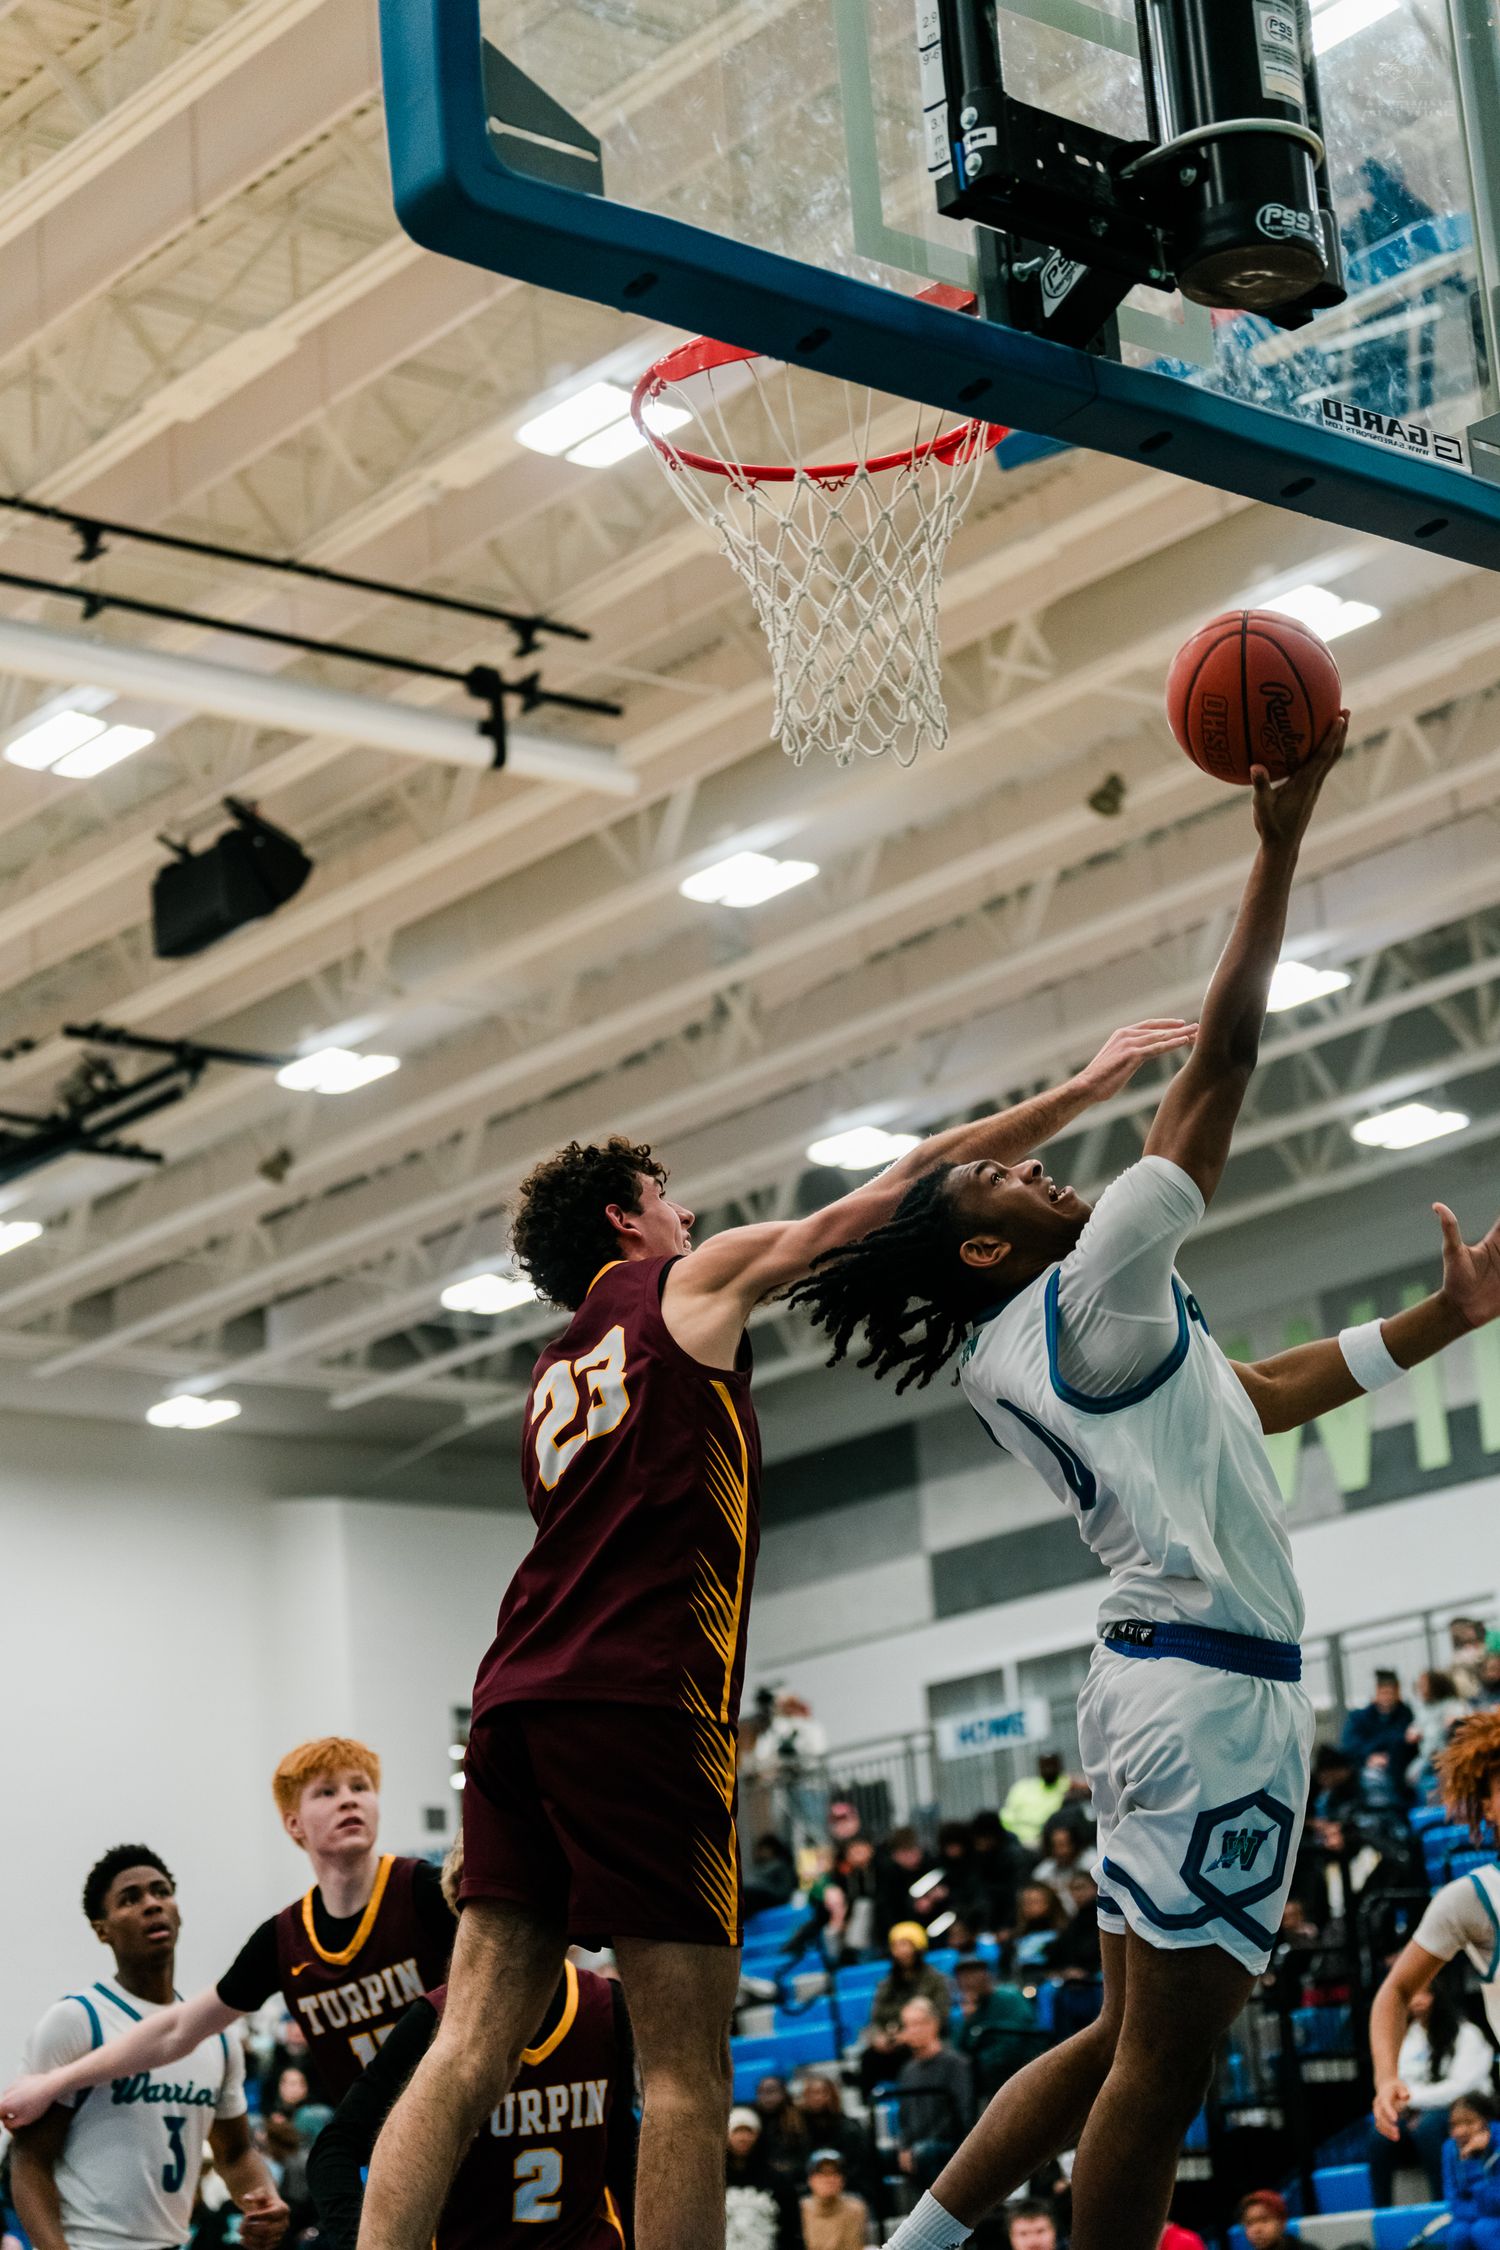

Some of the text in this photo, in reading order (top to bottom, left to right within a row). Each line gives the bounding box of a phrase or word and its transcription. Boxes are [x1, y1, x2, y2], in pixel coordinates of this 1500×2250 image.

[1269, 18, 1293, 37] PSS
[1264, 207, 1311, 231] PSS
[1259, 681, 1305, 773] Rawlin
[531, 1324, 631, 1492] 23
[296, 1957, 427, 2036] TURPIN
[111, 2070, 216, 2108] Warrio
[489, 2078, 609, 2138] URPIN
[162, 2115, 188, 2194] 3
[511, 2147, 564, 2224] 2
